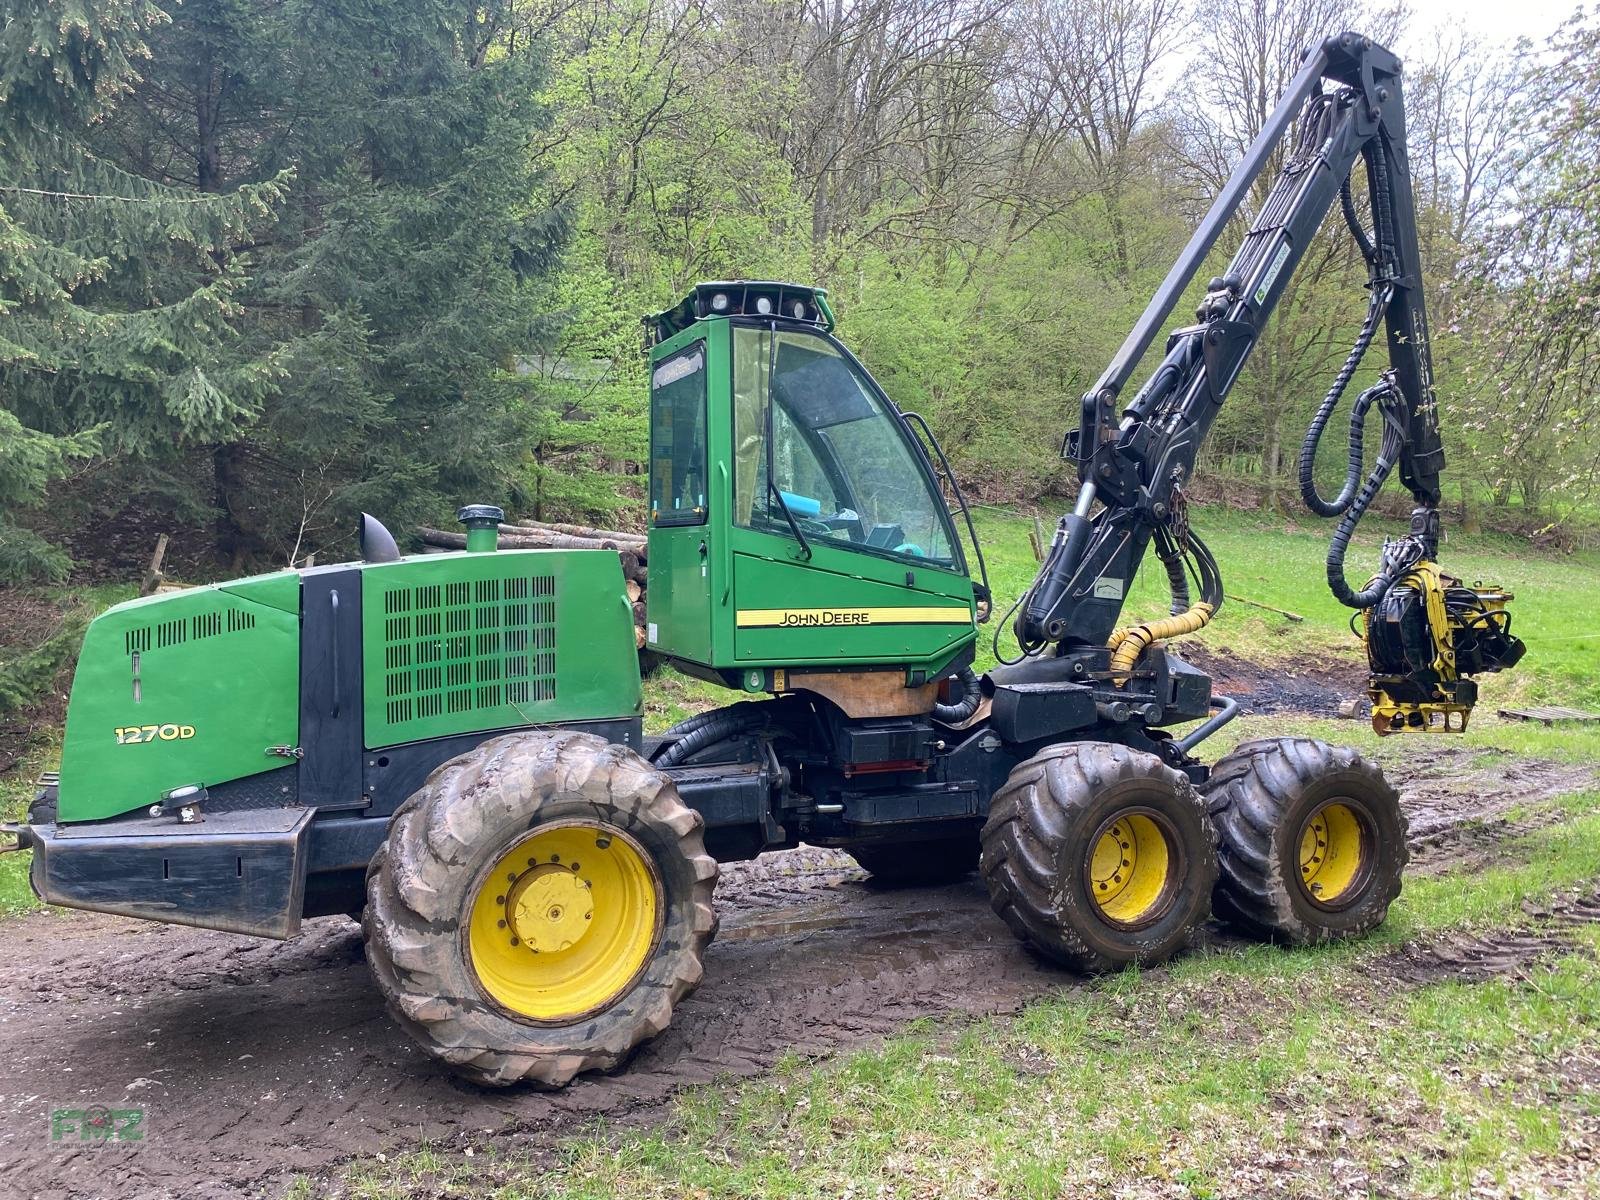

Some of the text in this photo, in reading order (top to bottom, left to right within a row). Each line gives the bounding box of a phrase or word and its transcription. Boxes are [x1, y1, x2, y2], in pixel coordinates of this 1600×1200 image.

[779, 611, 870, 625] JOHN DEERE
[114, 723, 196, 745] 1270D
